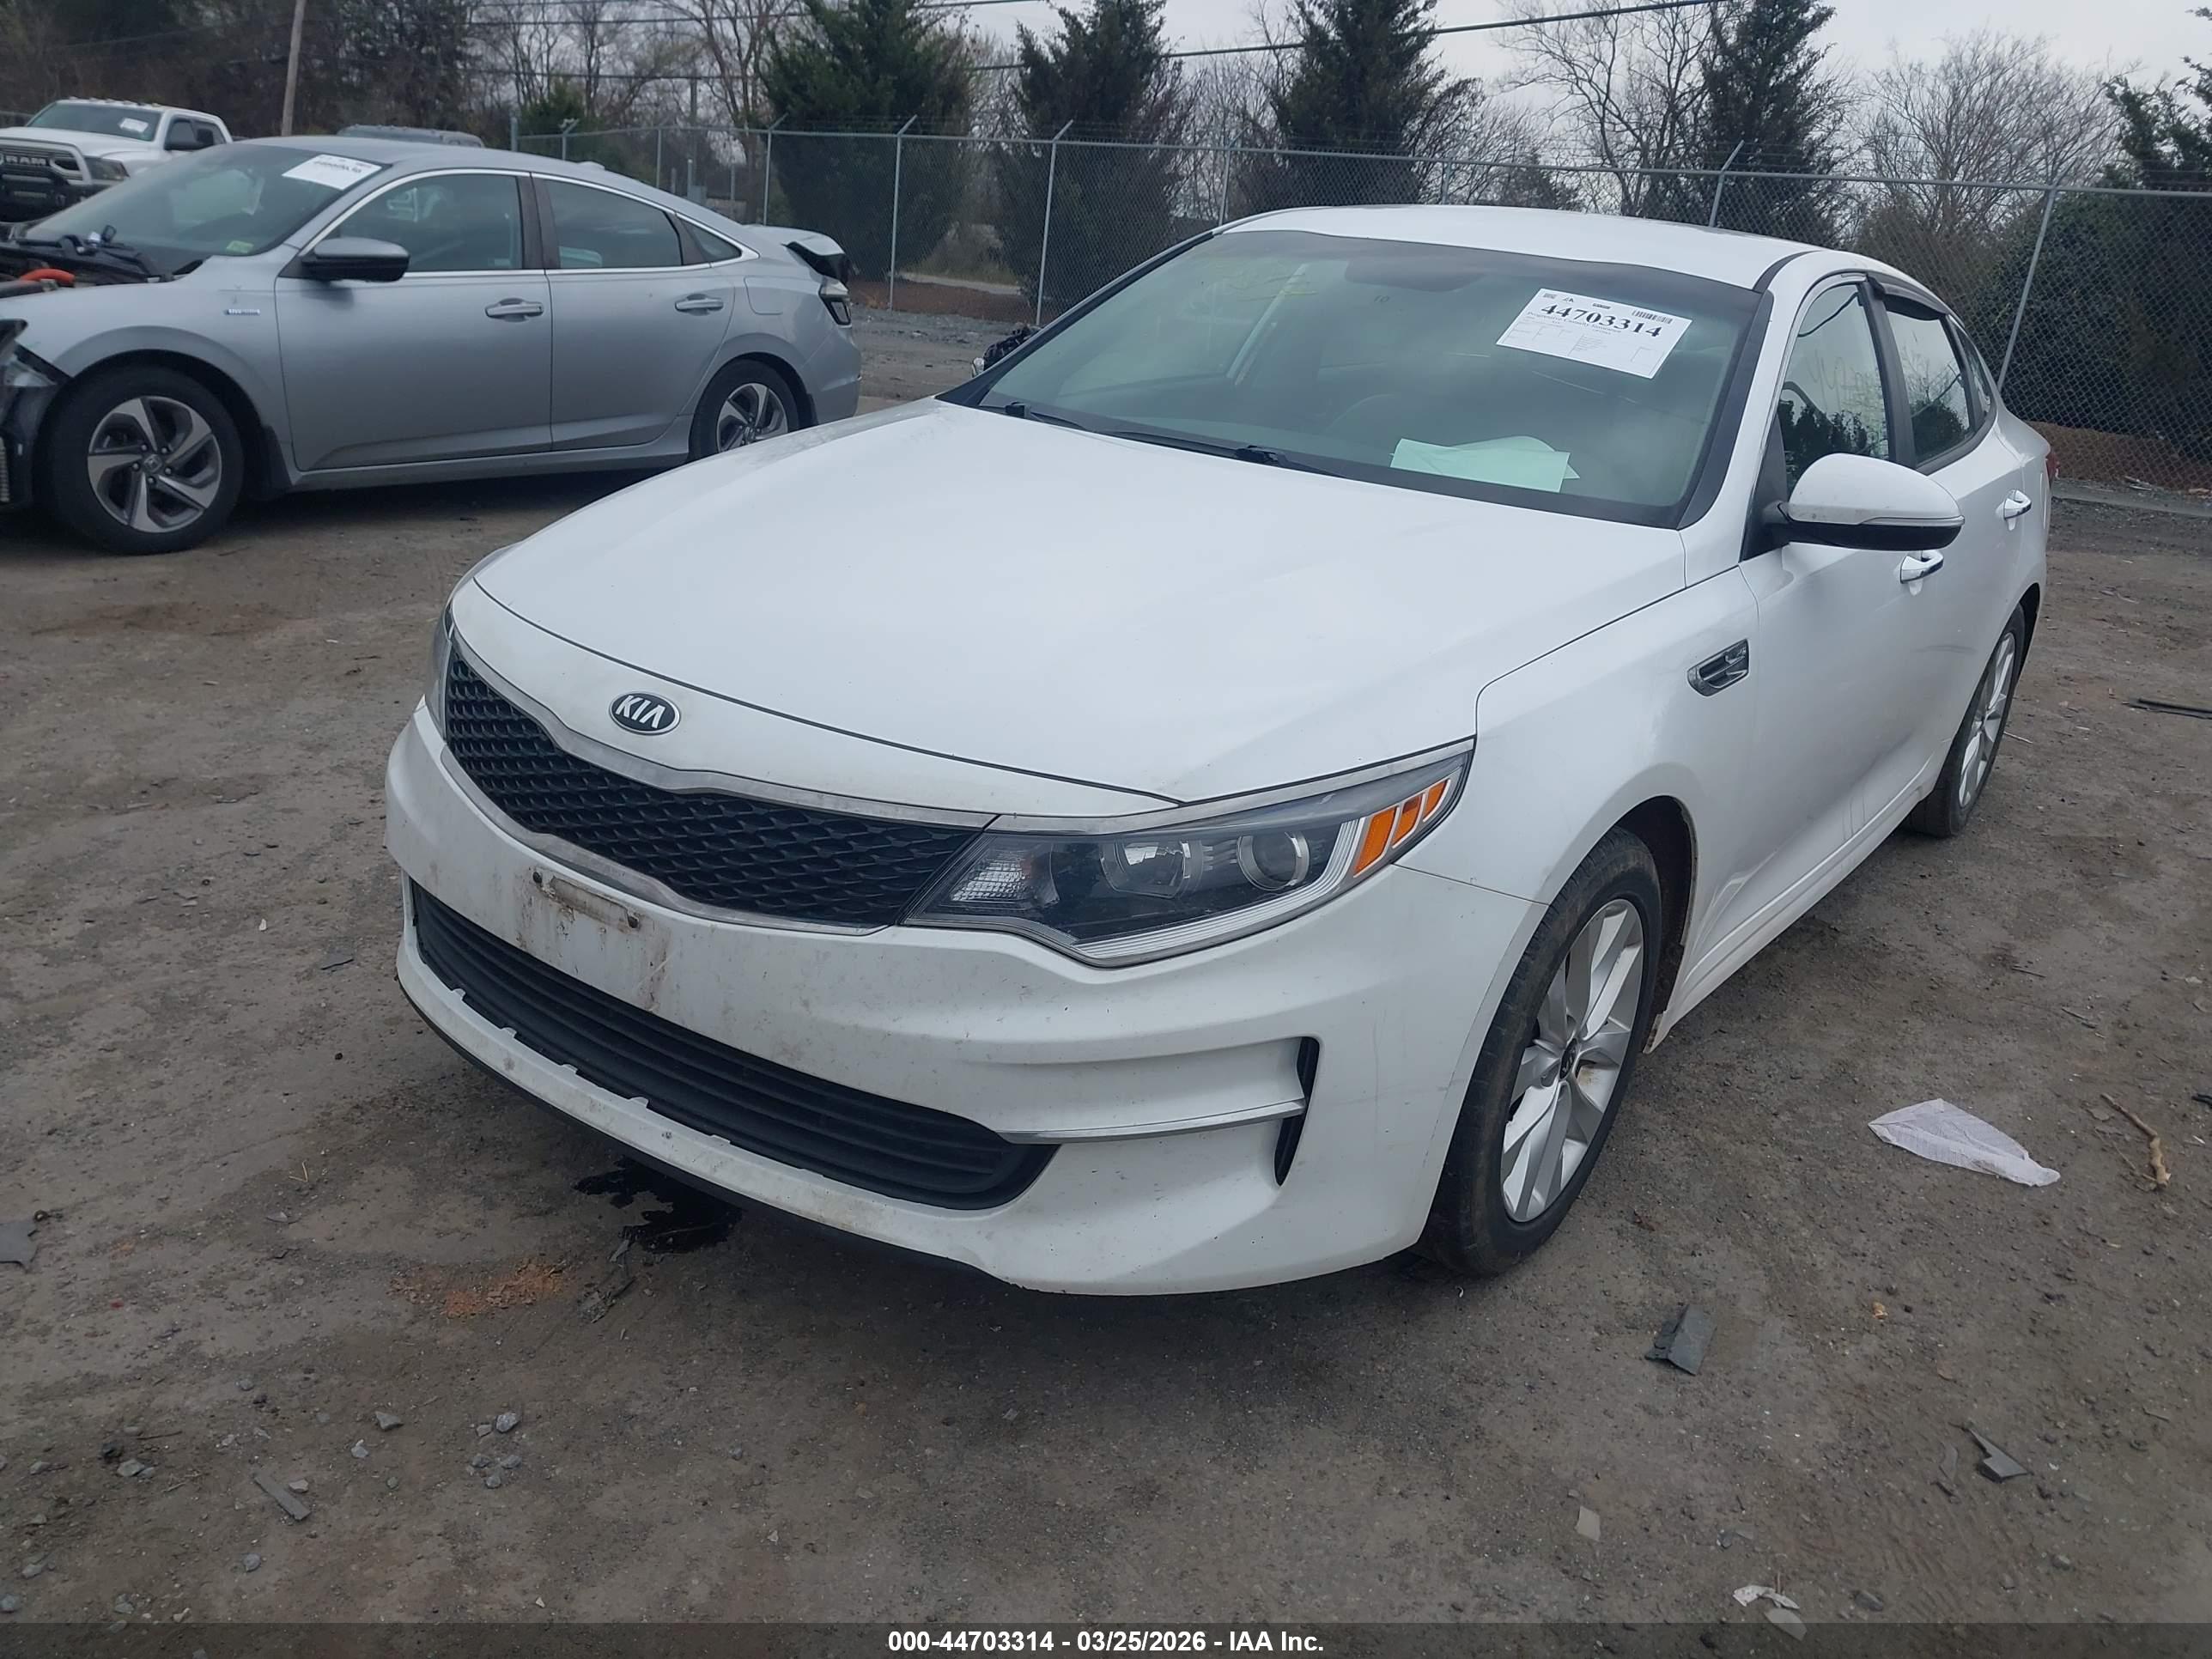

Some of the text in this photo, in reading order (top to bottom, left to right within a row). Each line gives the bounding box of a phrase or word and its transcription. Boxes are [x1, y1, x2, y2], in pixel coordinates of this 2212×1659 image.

[6, 155, 46, 166] RAM
[1541, 304, 1662, 337] 44703314
[615, 695, 665, 729] KIA
